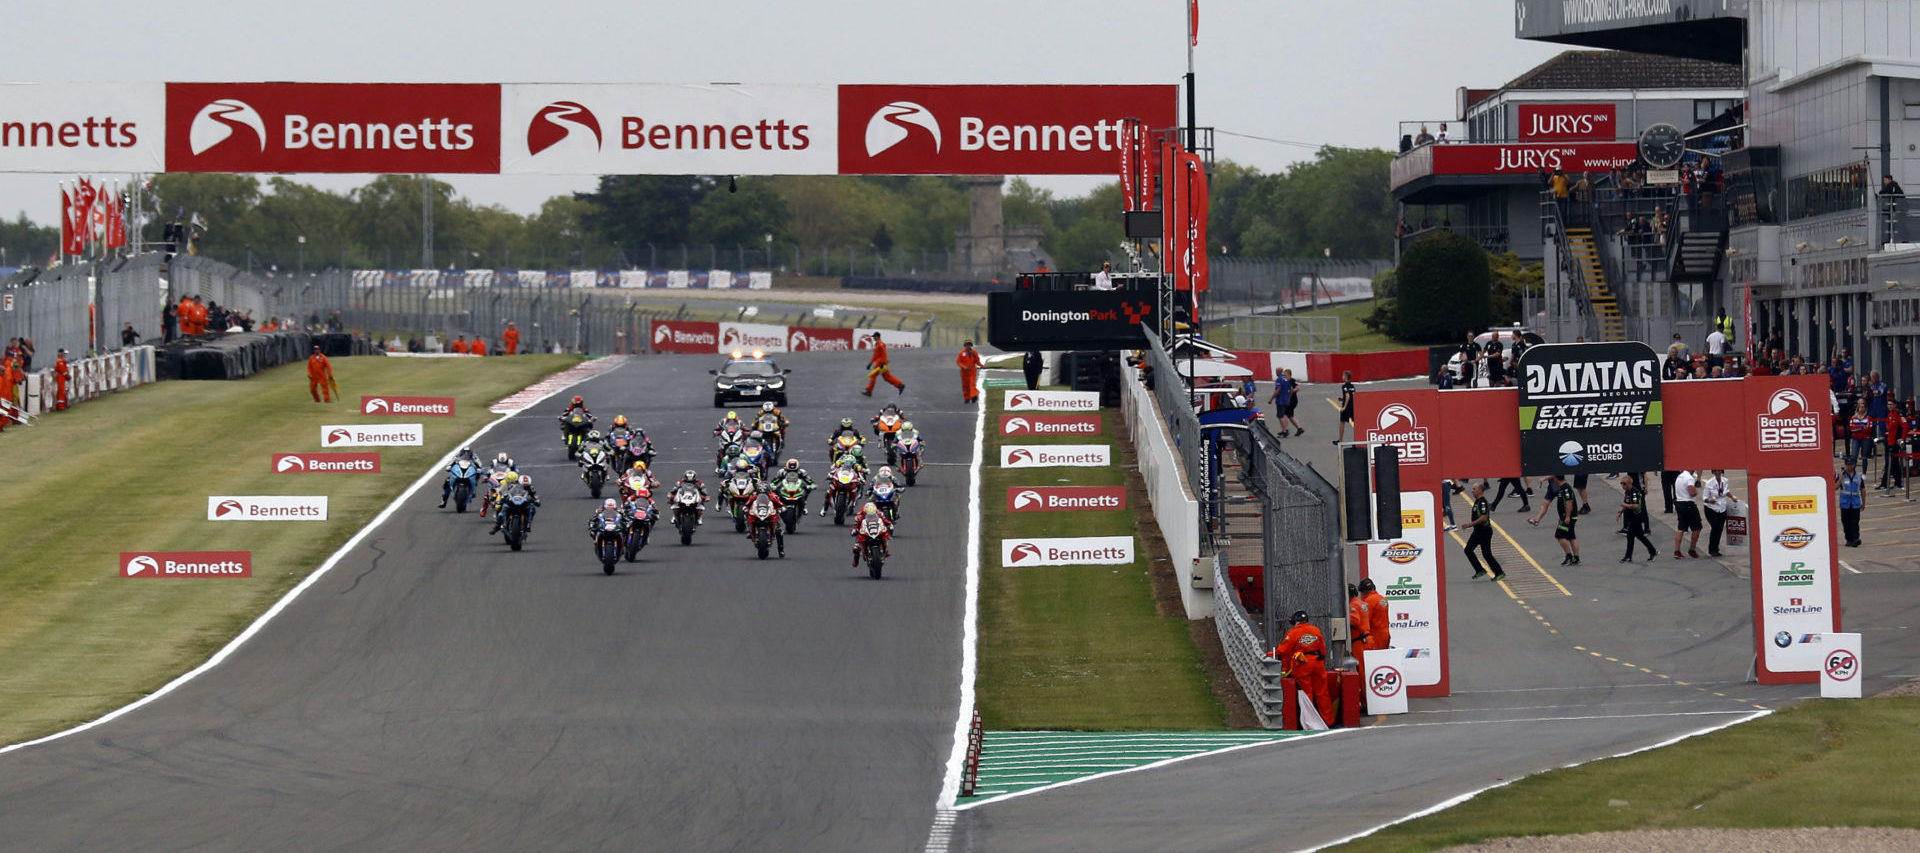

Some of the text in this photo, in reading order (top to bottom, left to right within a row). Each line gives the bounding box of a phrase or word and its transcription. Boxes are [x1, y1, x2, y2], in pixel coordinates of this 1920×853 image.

[1527, 113, 1608, 136] JURYS INN
[284, 114, 474, 151] Bennetts
[622, 116, 810, 151] Bennetts
[1495, 147, 1576, 170] JURYS INN
[5, 296, 12, 309] F
[674, 330, 715, 345] Bennetts
[743, 333, 782, 347] Bennetts
[1526, 360, 1654, 394] DATATAG
[393, 402, 449, 415] Bennetts
[1037, 397, 1094, 408] Bennetts
[1539, 401, 1647, 418] EXTREME
[1034, 421, 1096, 433] Bennetts
[1536, 415, 1644, 430] QUALIFYING
[1760, 416, 1816, 427] Bennetts
[357, 432, 417, 444] Bennetts
[1370, 431, 1425, 442] Bennetts
[1761, 427, 1817, 444] BSB
[1587, 443, 1622, 454] mcia
[1039, 453, 1103, 464] Bennetts
[1587, 453, 1623, 461] SECURED
[309, 459, 374, 472] Bennetts
[1048, 495, 1119, 507] Bennetts
[1772, 500, 1813, 510] PIRELLI
[249, 504, 320, 518] Bennetts
[1049, 547, 1126, 562] Bennetts
[165, 559, 243, 575] Bennetts
[1773, 605, 1823, 614] Stena Line
[1409, 619, 1429, 628] Line
[1829, 656, 1853, 670] 60
[1374, 673, 1397, 686] 60
